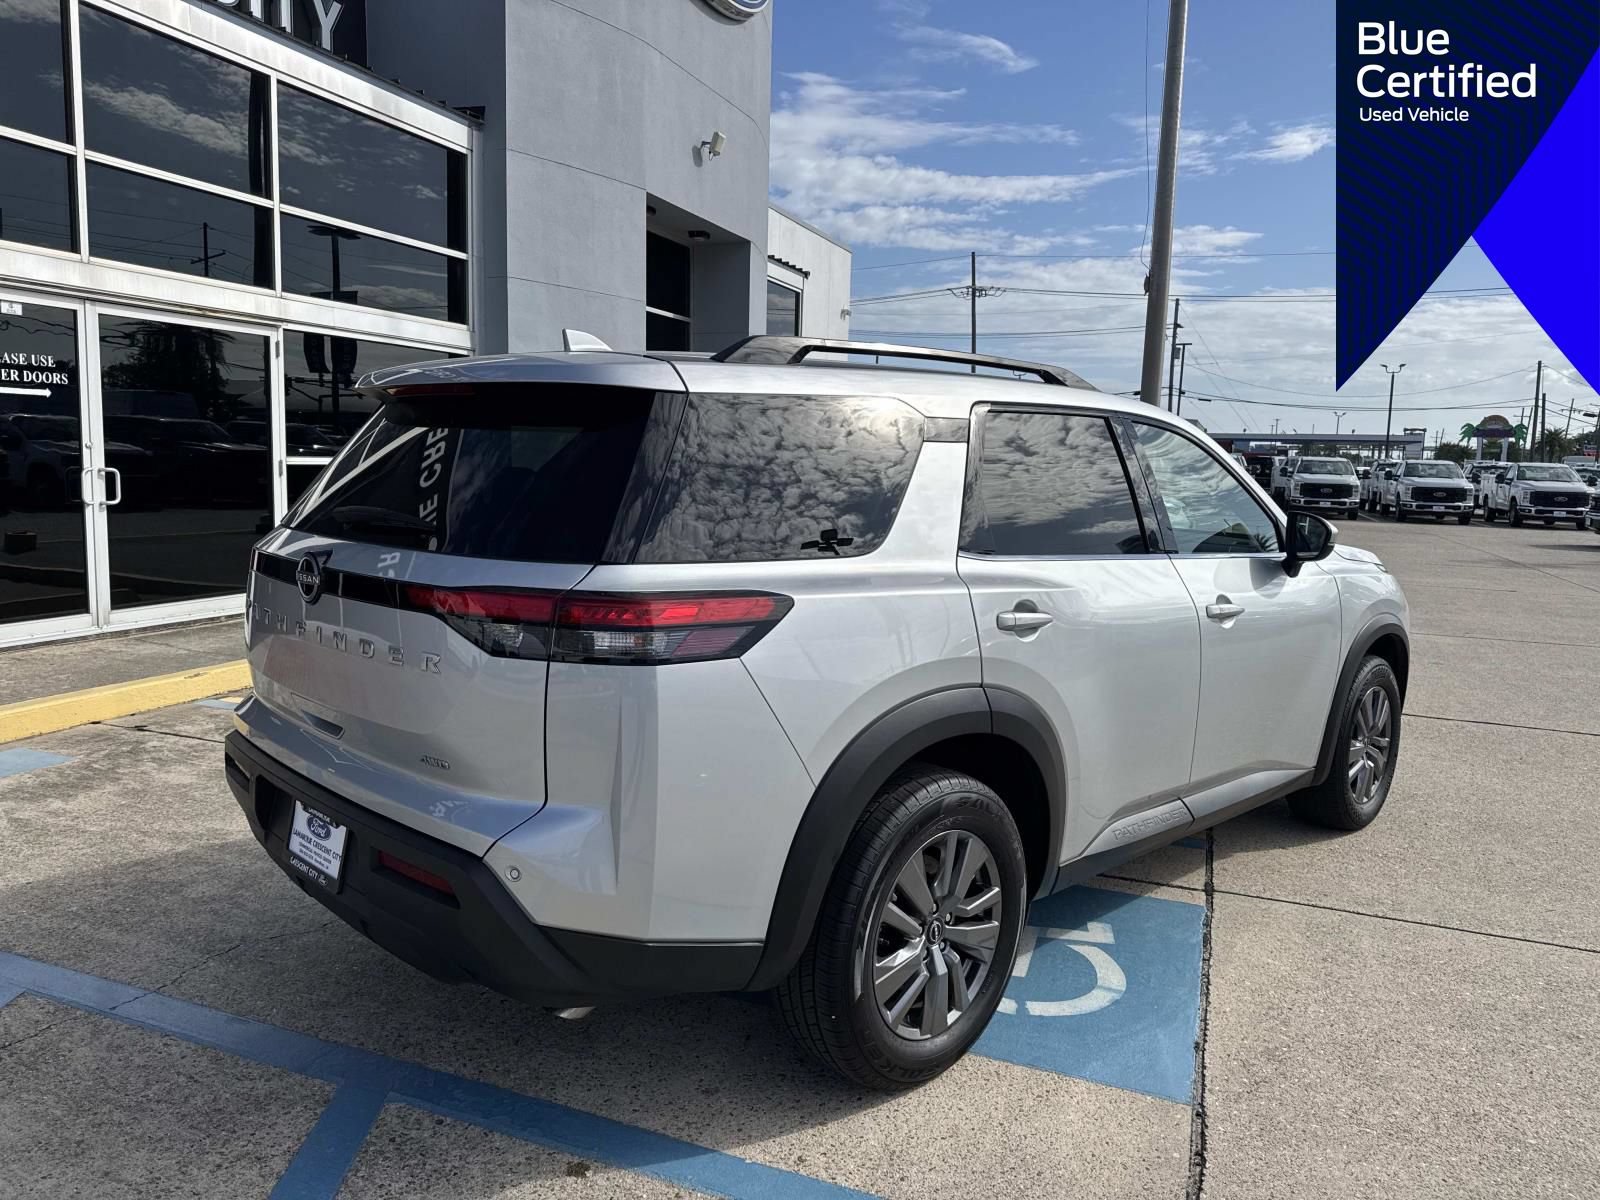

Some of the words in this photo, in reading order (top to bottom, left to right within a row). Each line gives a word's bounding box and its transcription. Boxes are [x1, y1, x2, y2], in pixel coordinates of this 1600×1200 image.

[0, 351, 28, 365] ASE
[31, 354, 56, 368] USE
[23, 370, 69, 385] DOORS
[310, 817, 328, 838] Ford
[1112, 807, 1188, 841] PATHFINDER
